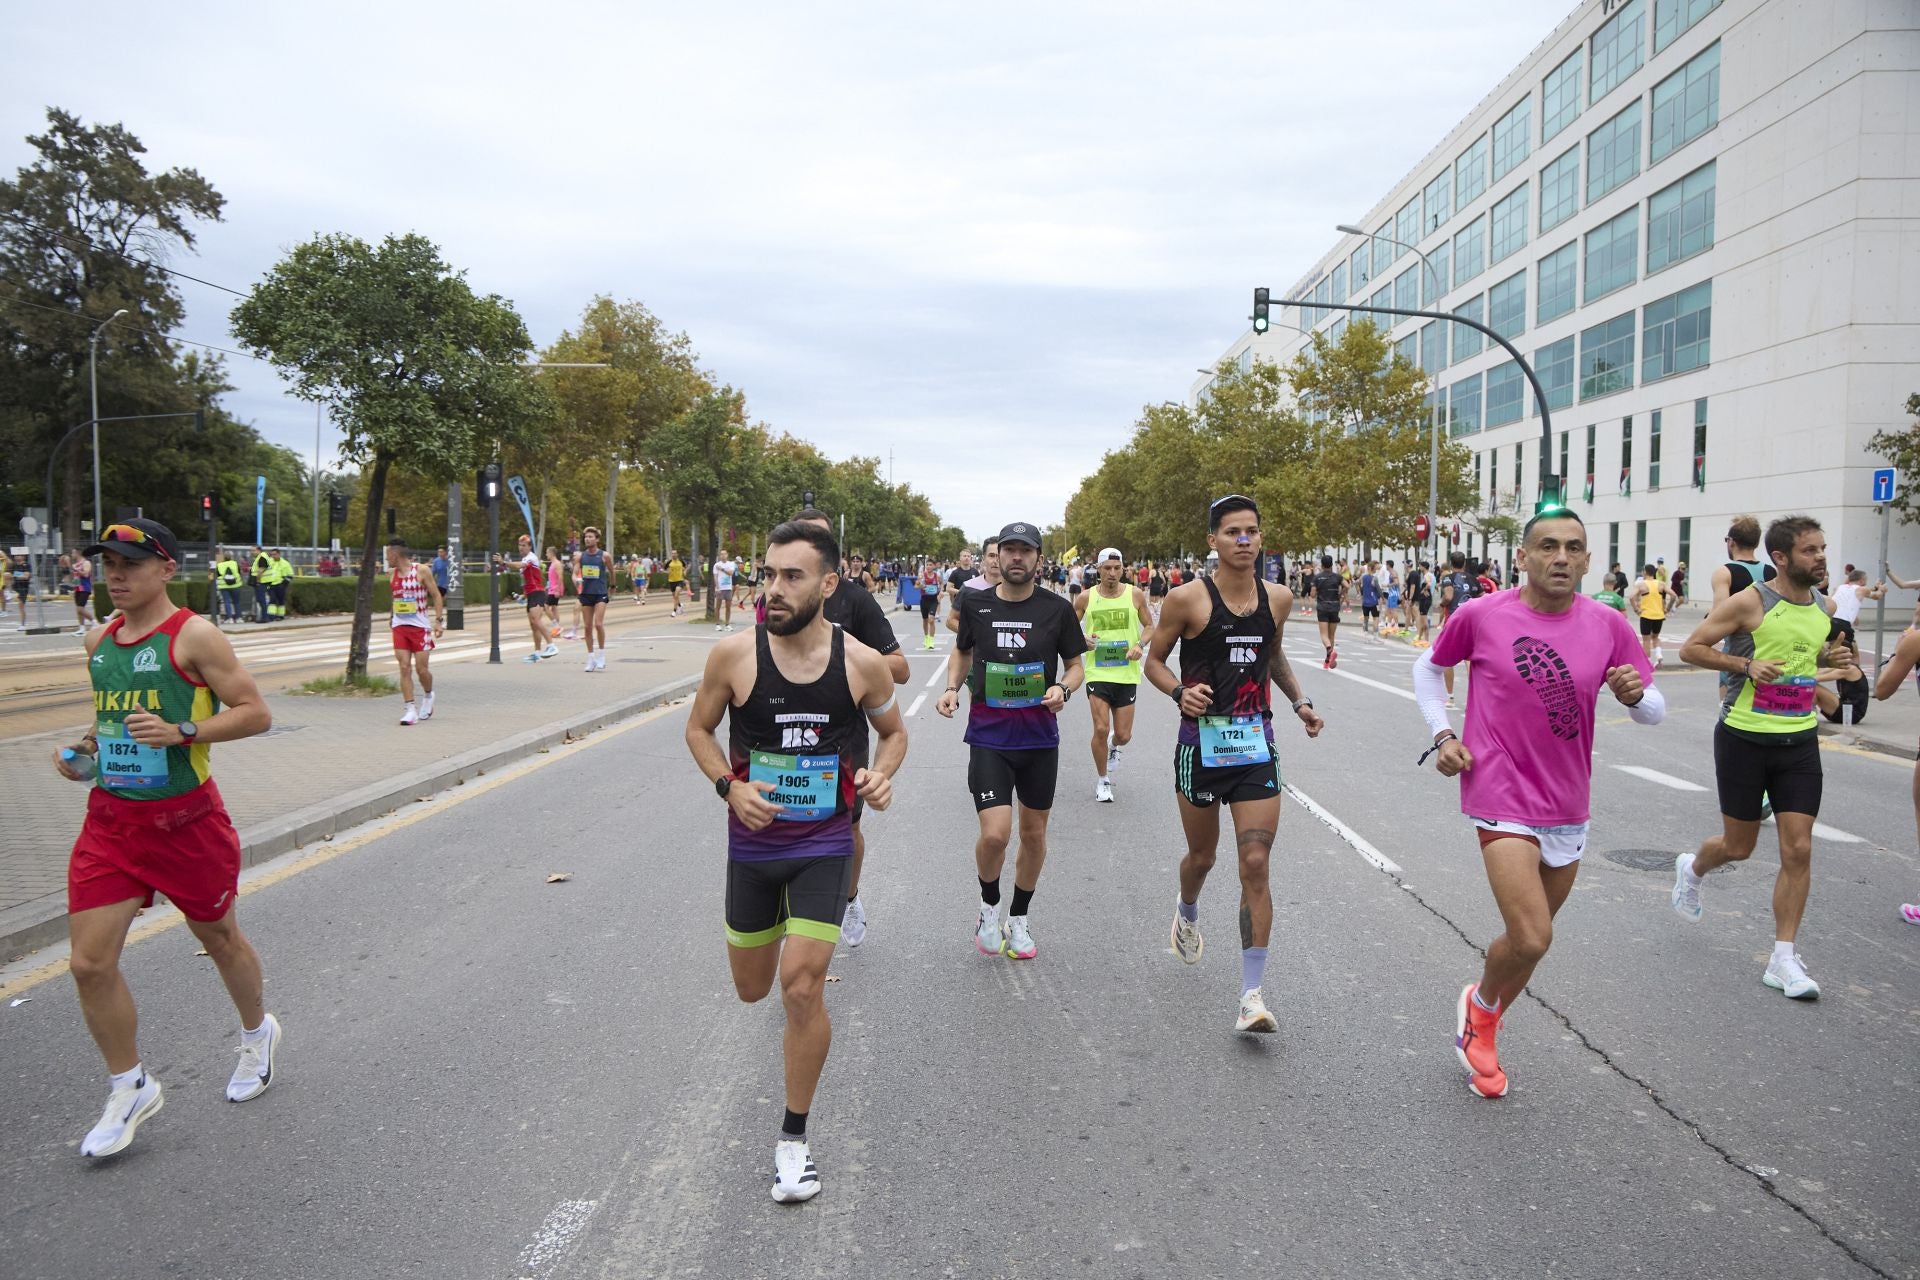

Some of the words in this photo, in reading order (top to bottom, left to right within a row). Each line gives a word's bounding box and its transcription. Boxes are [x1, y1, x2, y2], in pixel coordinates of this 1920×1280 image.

[1004, 677, 1026, 687] 1180
[1536, 680, 1574, 694] PRIMEIRA
[1002, 689, 1028, 698] SERGIO
[1539, 685, 1575, 699] CARREIRA
[1542, 691, 1576, 705] POPULAR
[1220, 730, 1244, 740] 1721
[108, 743, 139, 756] 1874
[106, 761, 142, 773] Alberto
[812, 760, 834, 768] ZURICH
[777, 774, 810, 788] 1905
[768, 791, 816, 805] CRISTIAN
